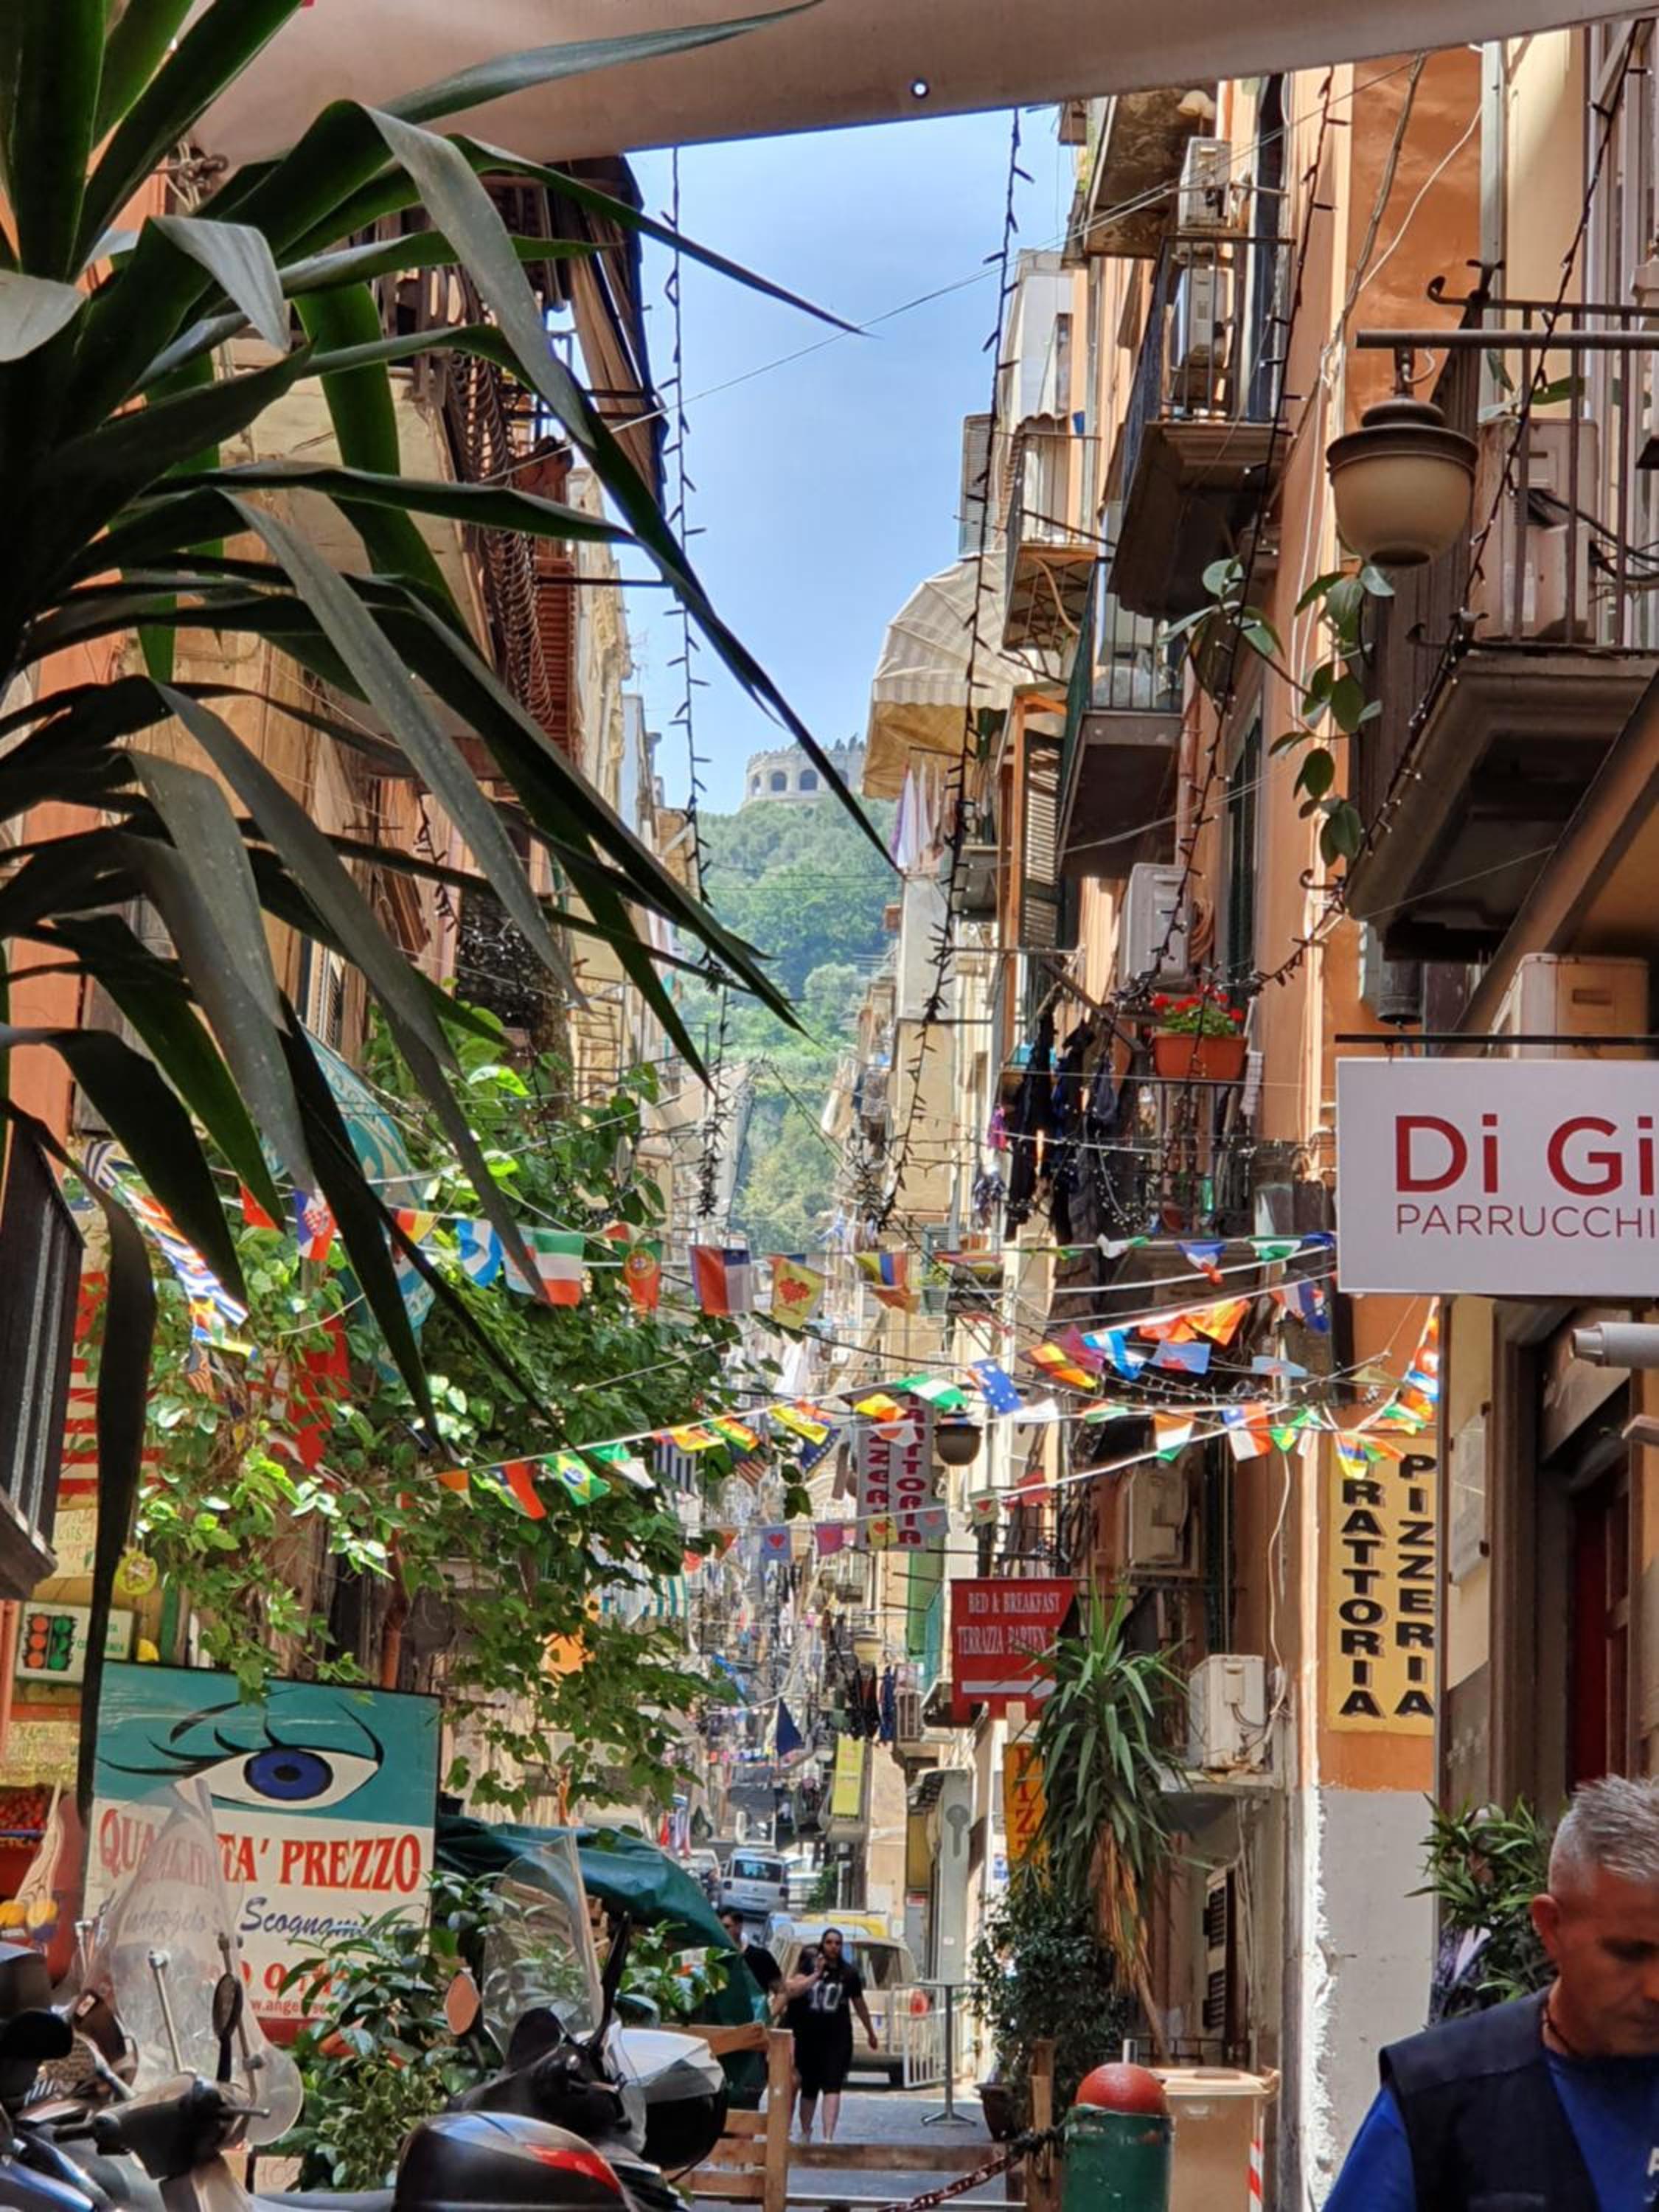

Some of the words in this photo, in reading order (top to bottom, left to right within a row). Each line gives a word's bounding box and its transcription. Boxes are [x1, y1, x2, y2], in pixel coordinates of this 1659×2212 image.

[1396, 1113, 1498, 1193] Di
[1547, 1116, 1654, 1196] Gi
[1397, 1203, 1655, 1238] PARRUCCHI
[968, 1593, 989, 1613] BED
[1003, 1593, 1061, 1613] BREAKFAST
[1339, 1467, 1384, 1717] RATTORIA
[1394, 1453, 1436, 1717] PIZZERIA
[957, 1626, 1004, 1655] TERRAZZA
[279, 1833, 422, 1893] PREZZO
[810, 1980, 843, 2010] 10
